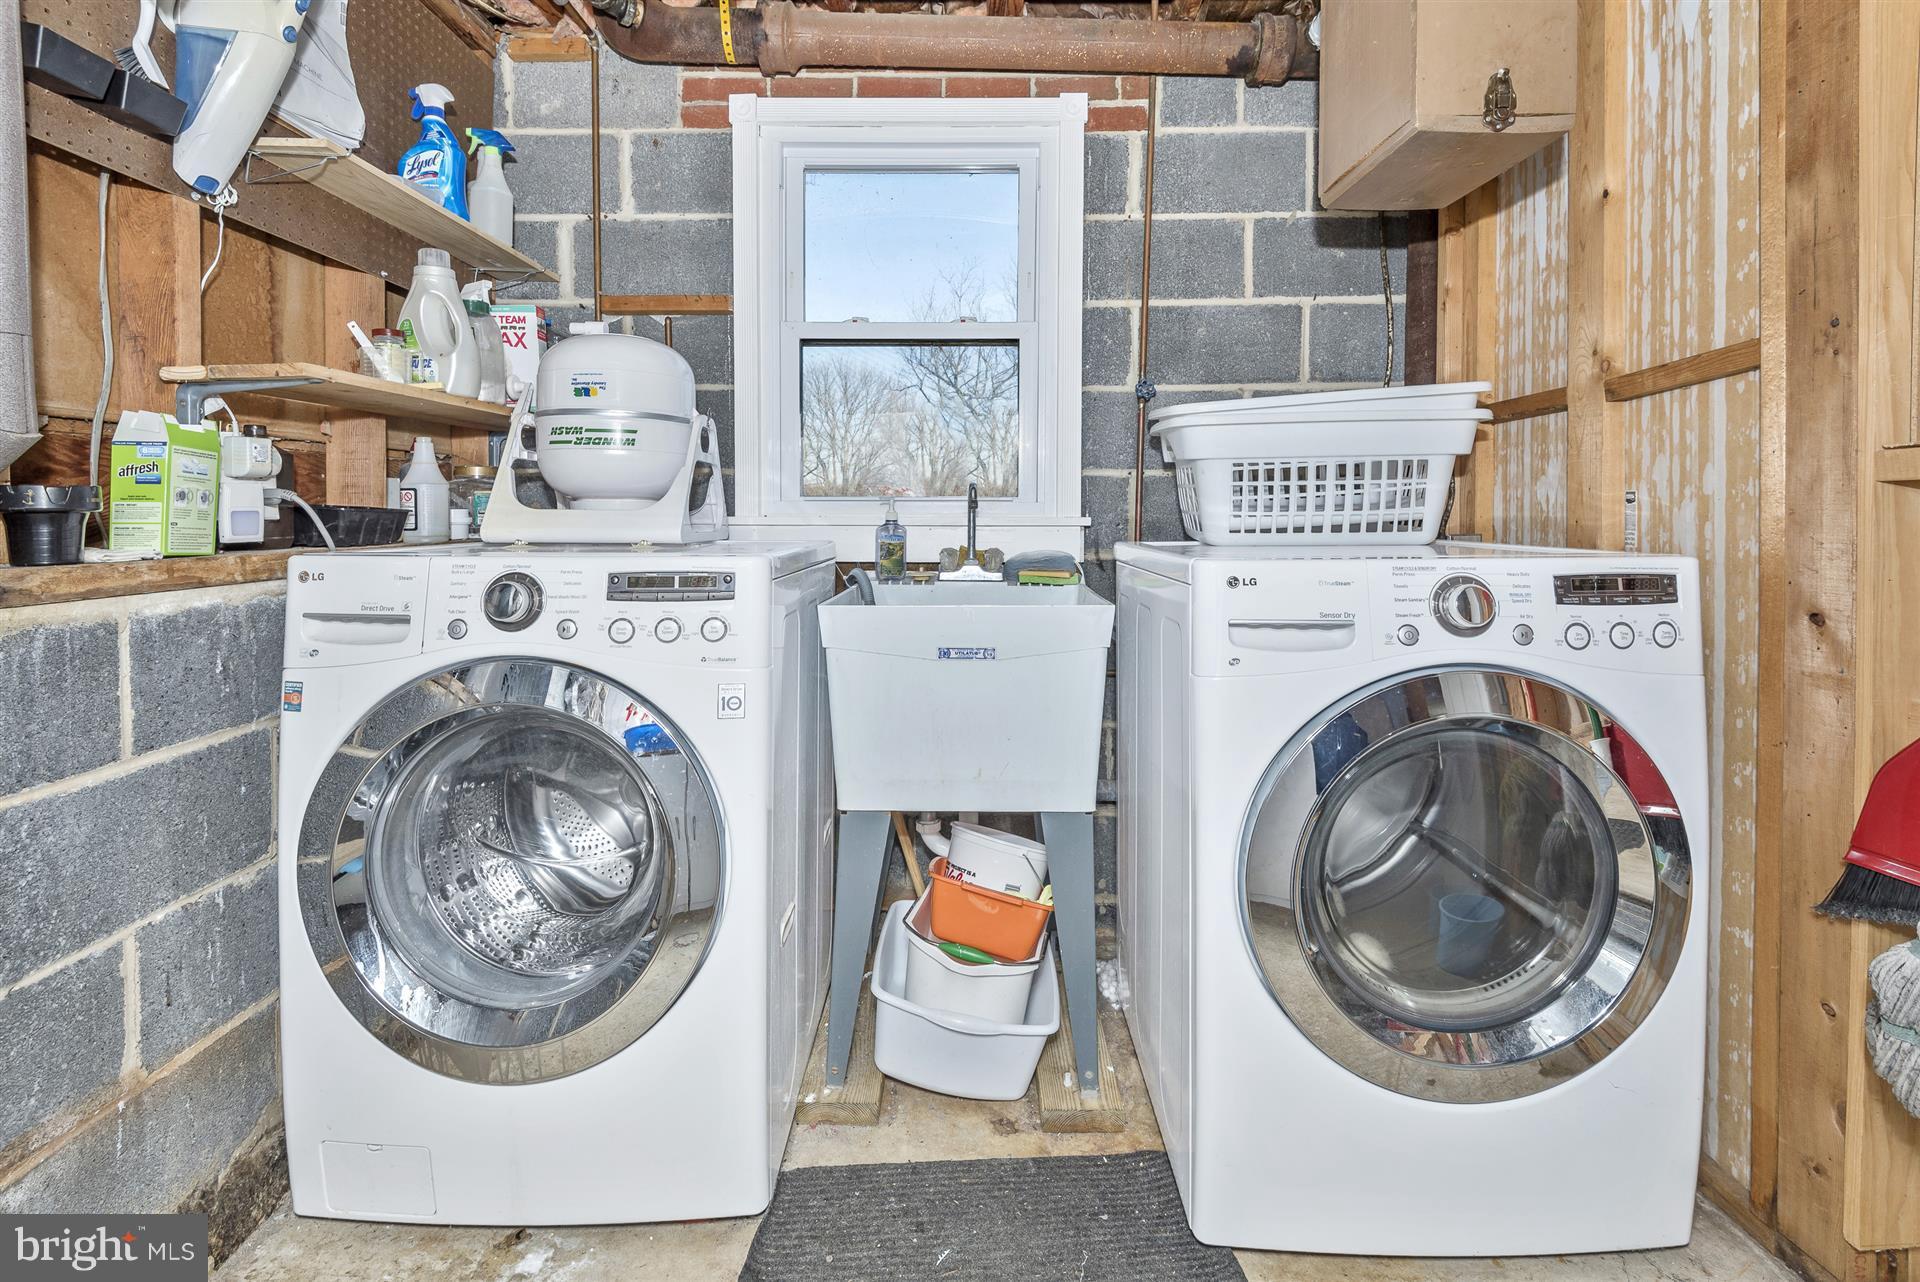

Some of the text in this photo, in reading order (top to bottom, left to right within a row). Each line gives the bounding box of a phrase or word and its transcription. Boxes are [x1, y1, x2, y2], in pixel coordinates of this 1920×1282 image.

[406, 151, 441, 176] Lysol
[499, 315, 526, 324] TEAM
[550, 426, 583, 436] WASH
[573, 436, 636, 447] WNDER
[118, 460, 159, 478] affresh
[312, 573, 325, 581] LG
[1242, 577, 1257, 586] LG
[361, 604, 395, 613] Direct Drive
[1320, 611, 1356, 620] Sensor Dry
